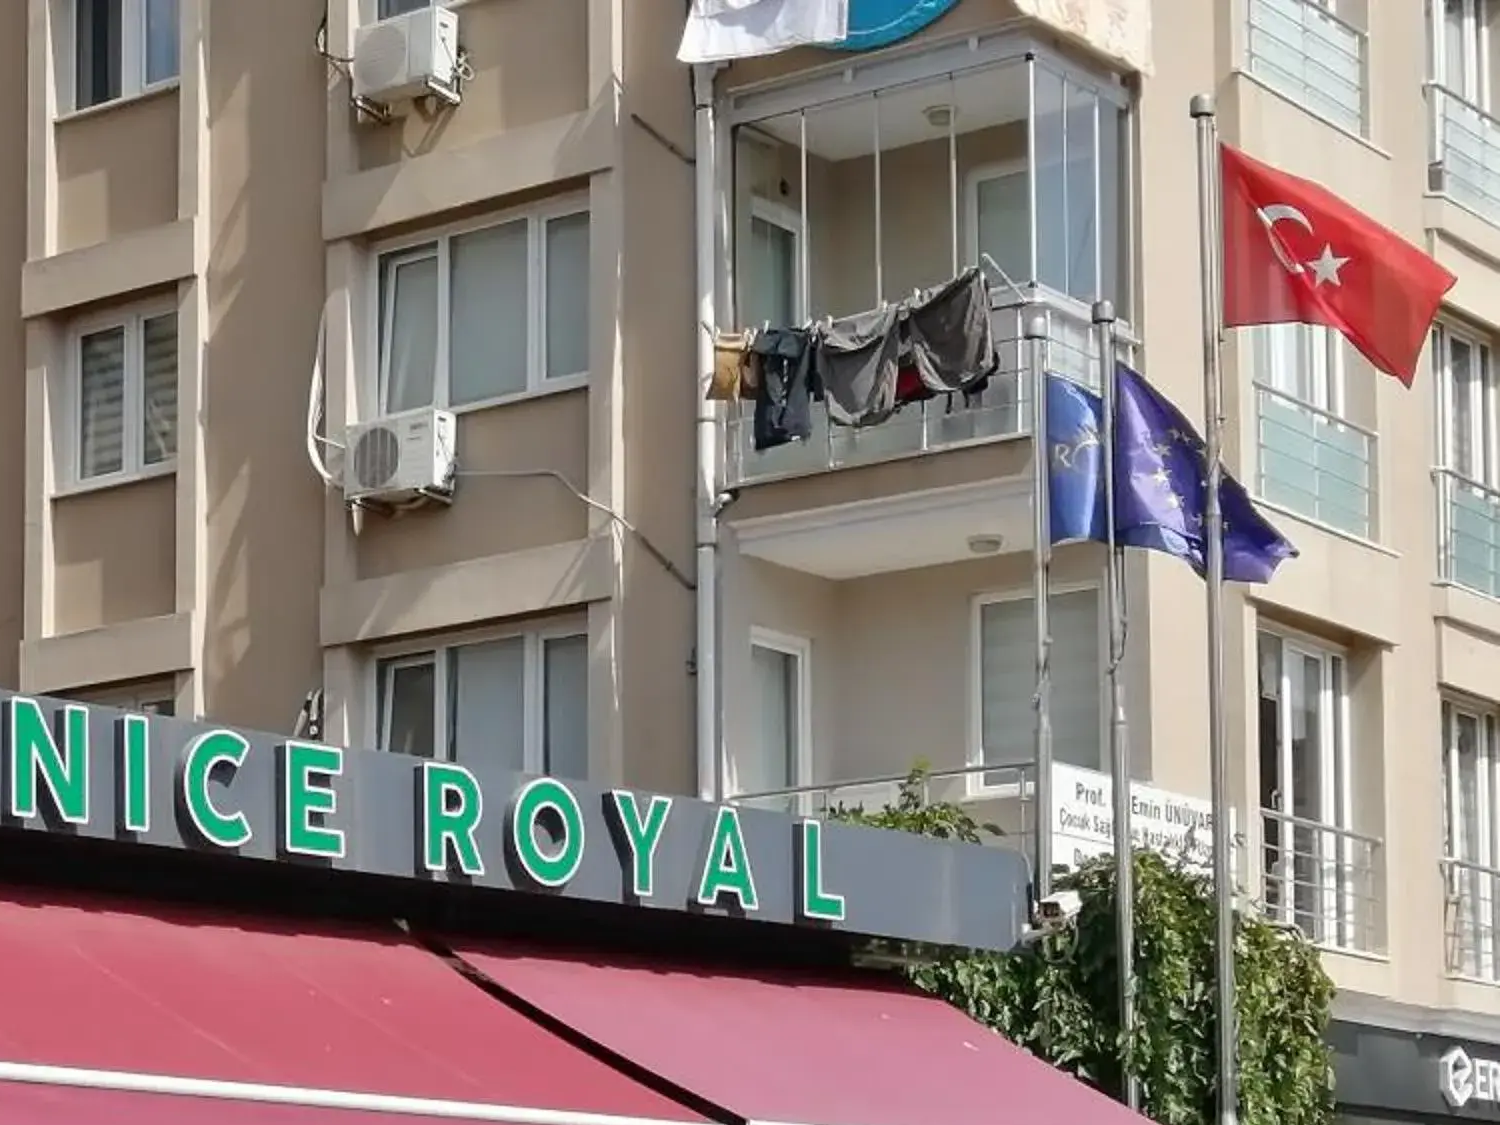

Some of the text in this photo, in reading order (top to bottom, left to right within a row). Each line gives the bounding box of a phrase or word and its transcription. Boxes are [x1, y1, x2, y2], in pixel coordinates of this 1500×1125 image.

[8, 695, 846, 921] NICE ROYAL
[1131, 795, 1161, 821] Emin
